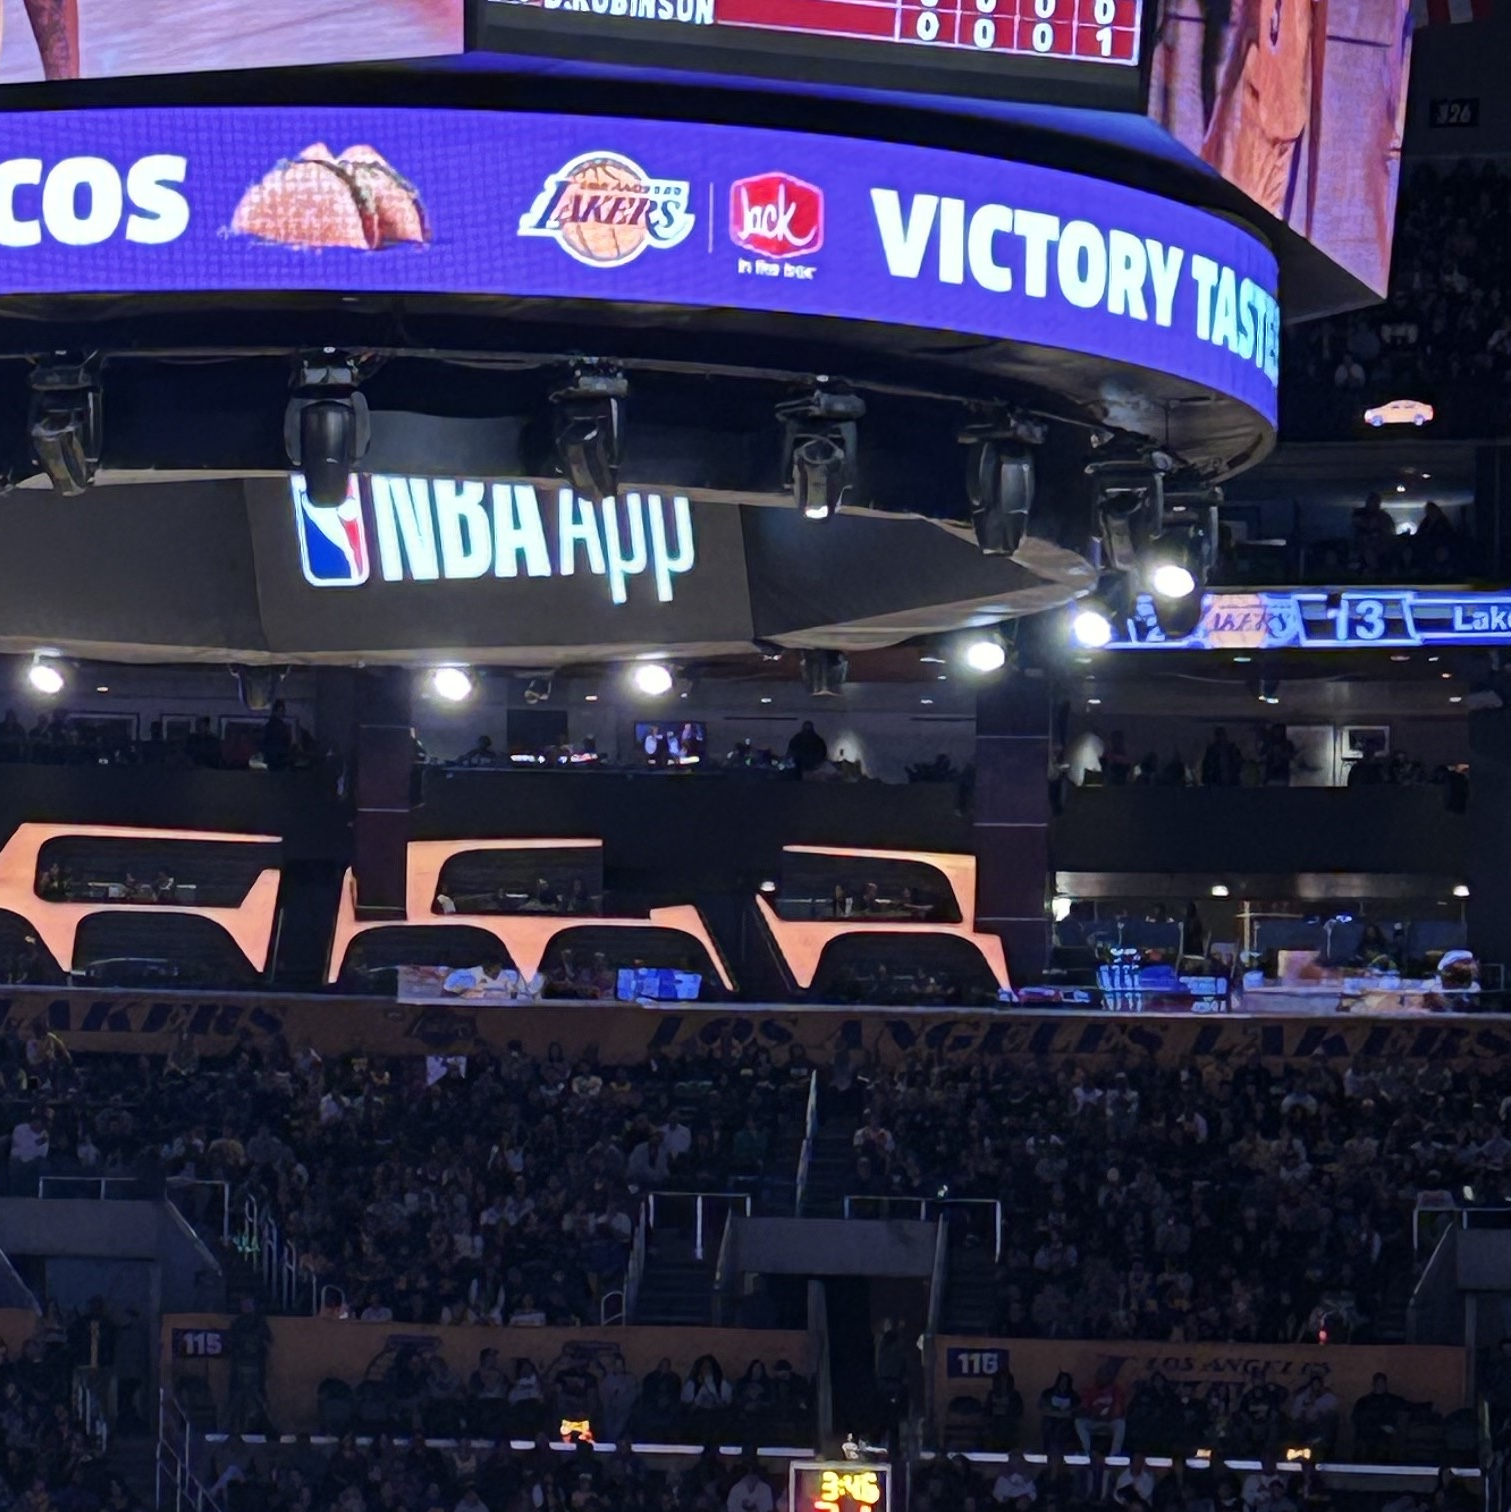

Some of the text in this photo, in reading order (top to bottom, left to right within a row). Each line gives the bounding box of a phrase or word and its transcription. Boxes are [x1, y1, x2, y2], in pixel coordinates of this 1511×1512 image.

[544, 0, 715, 24] .OBINSON
[917, 12, 939, 41] 0
[974, 18, 995, 49] 0
[1032, 22, 1053, 52] 0
[1096, 29, 1112, 57] 1
[533, 180, 682, 242] LAKERS
[869, 187, 1185, 328] VICTORY
[370, 472, 696, 603] NBA App
[185, 1333, 223, 1355] 115
[821, 1471, 881, 1504] 3:46
